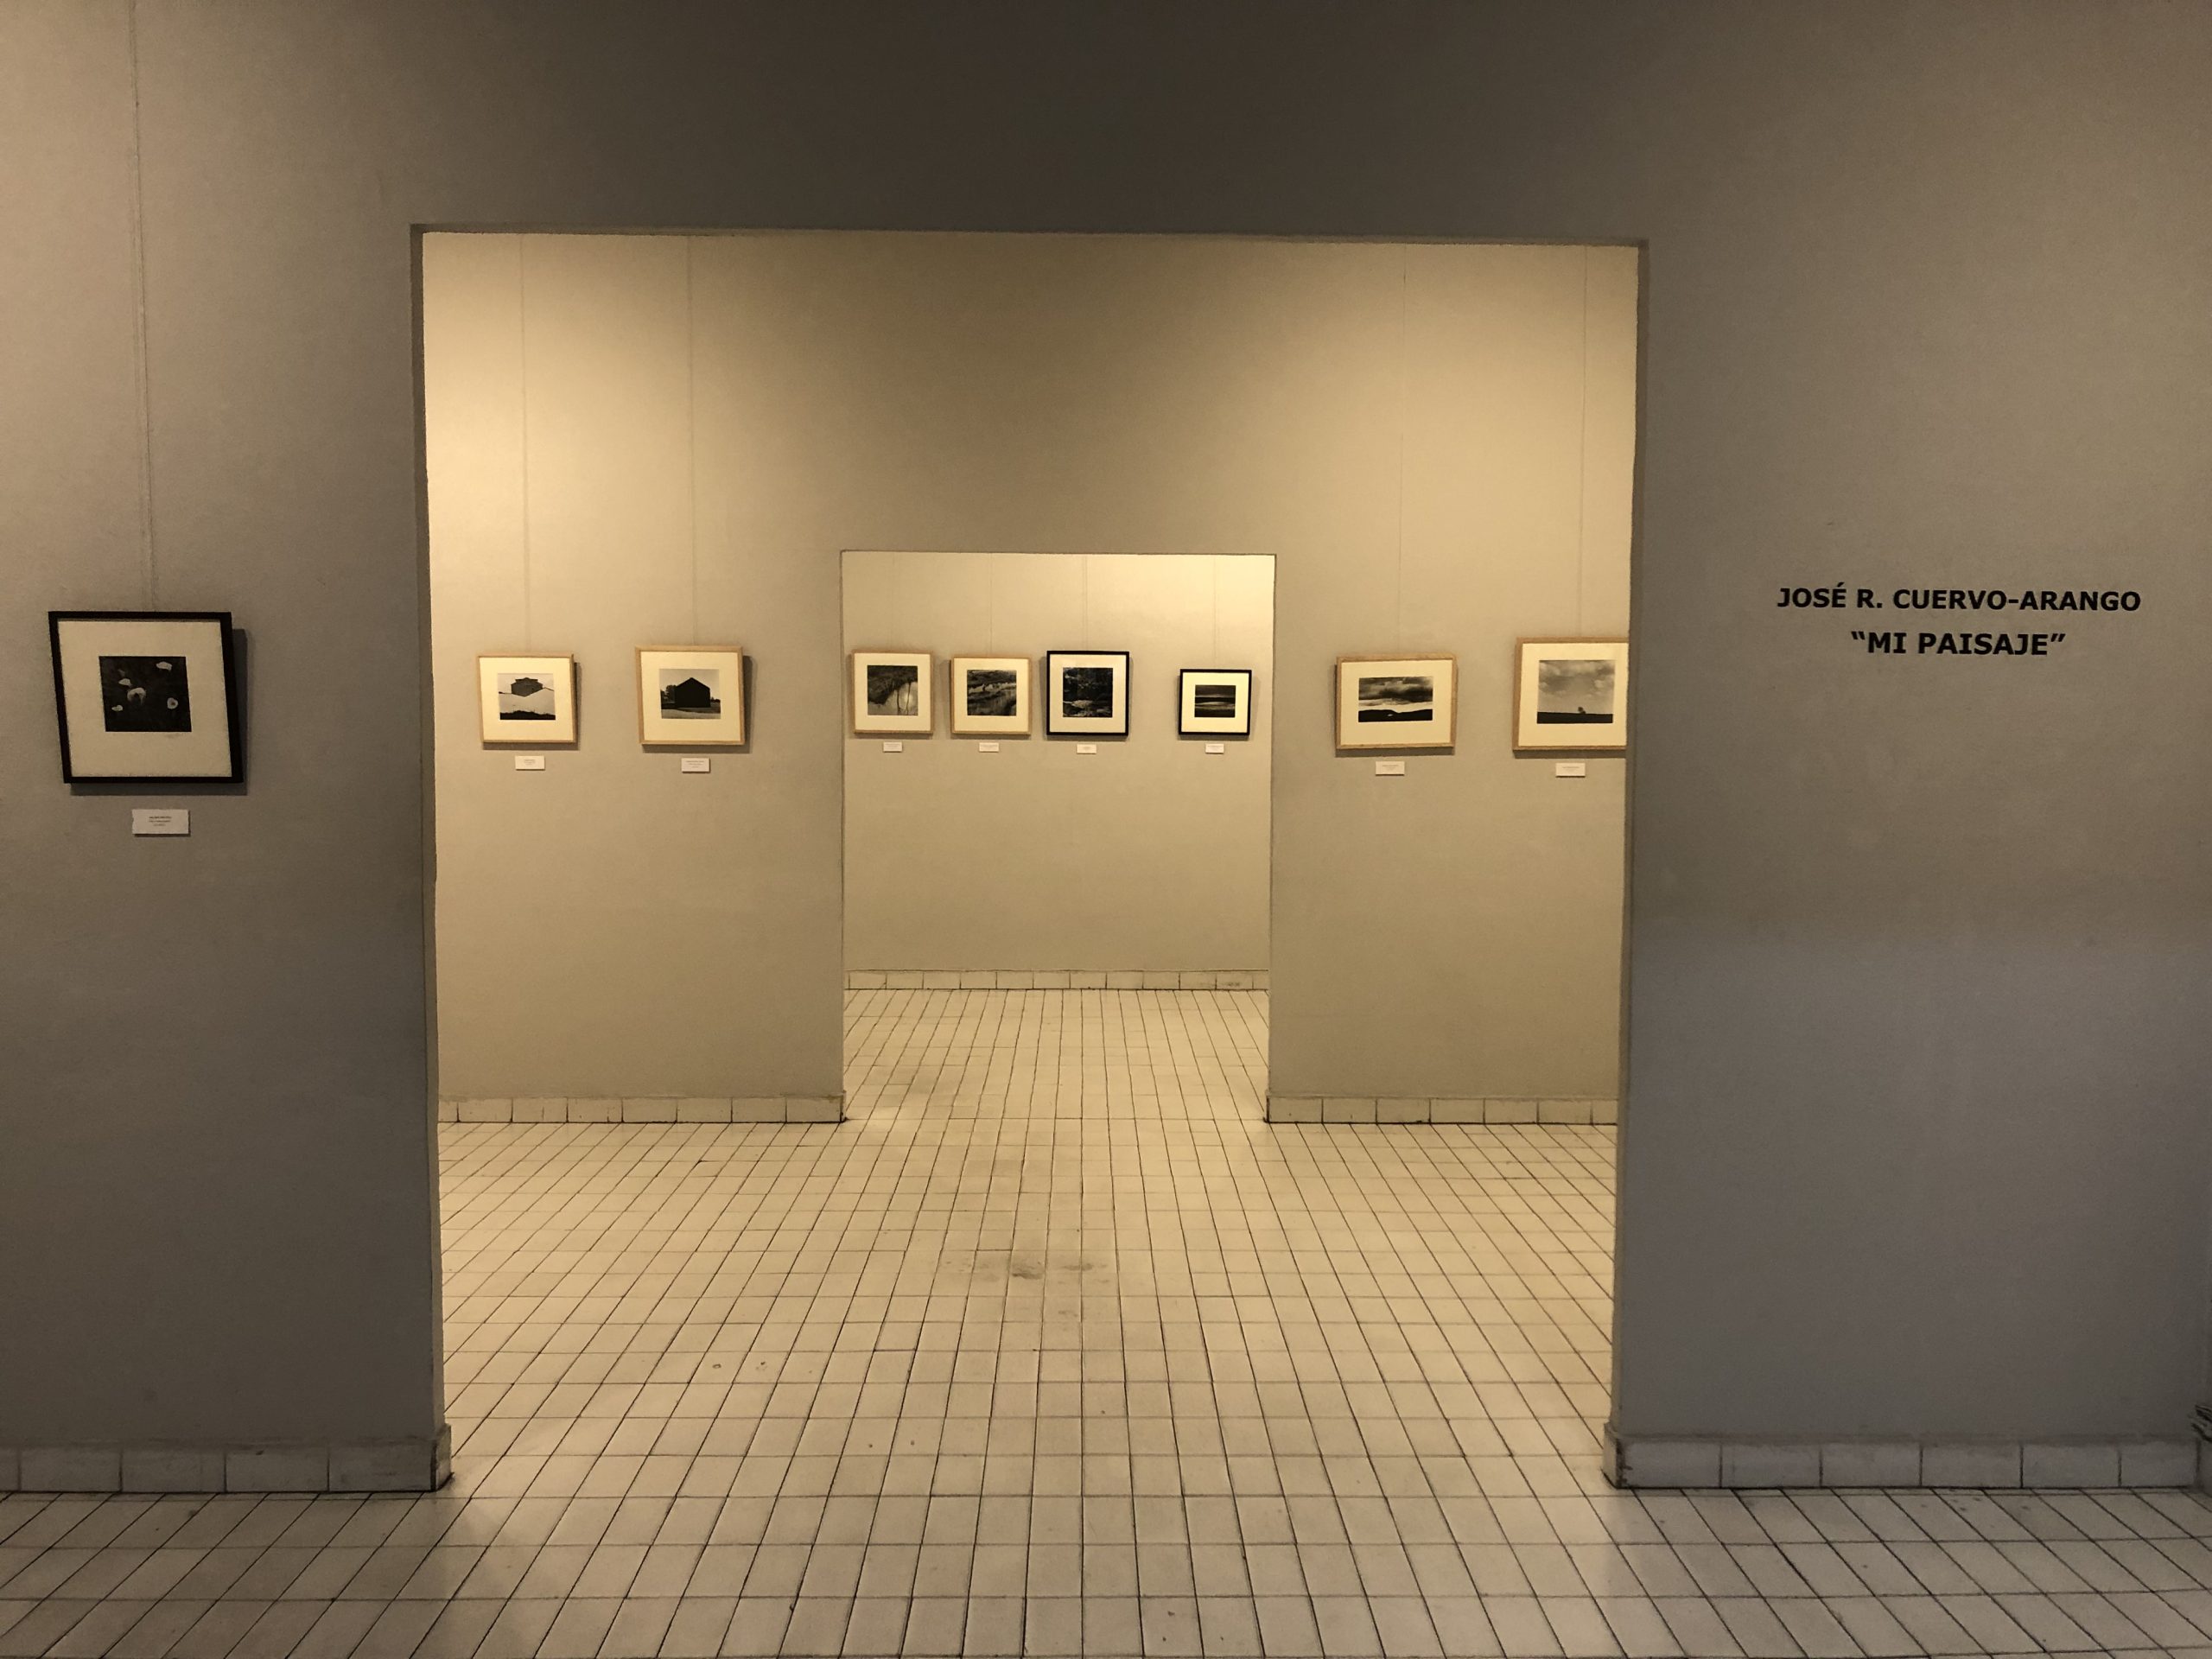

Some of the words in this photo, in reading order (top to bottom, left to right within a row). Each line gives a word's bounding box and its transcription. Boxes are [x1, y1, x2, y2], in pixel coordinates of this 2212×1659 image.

[1777, 582, 1847, 608] JOSÉ
[1856, 588, 1883, 609] R.
[1892, 588, 2141, 612] CUERVO-ARANGO
[1851, 631, 1907, 654] “MI
[1917, 632, 2066, 656] PAISAJE”
